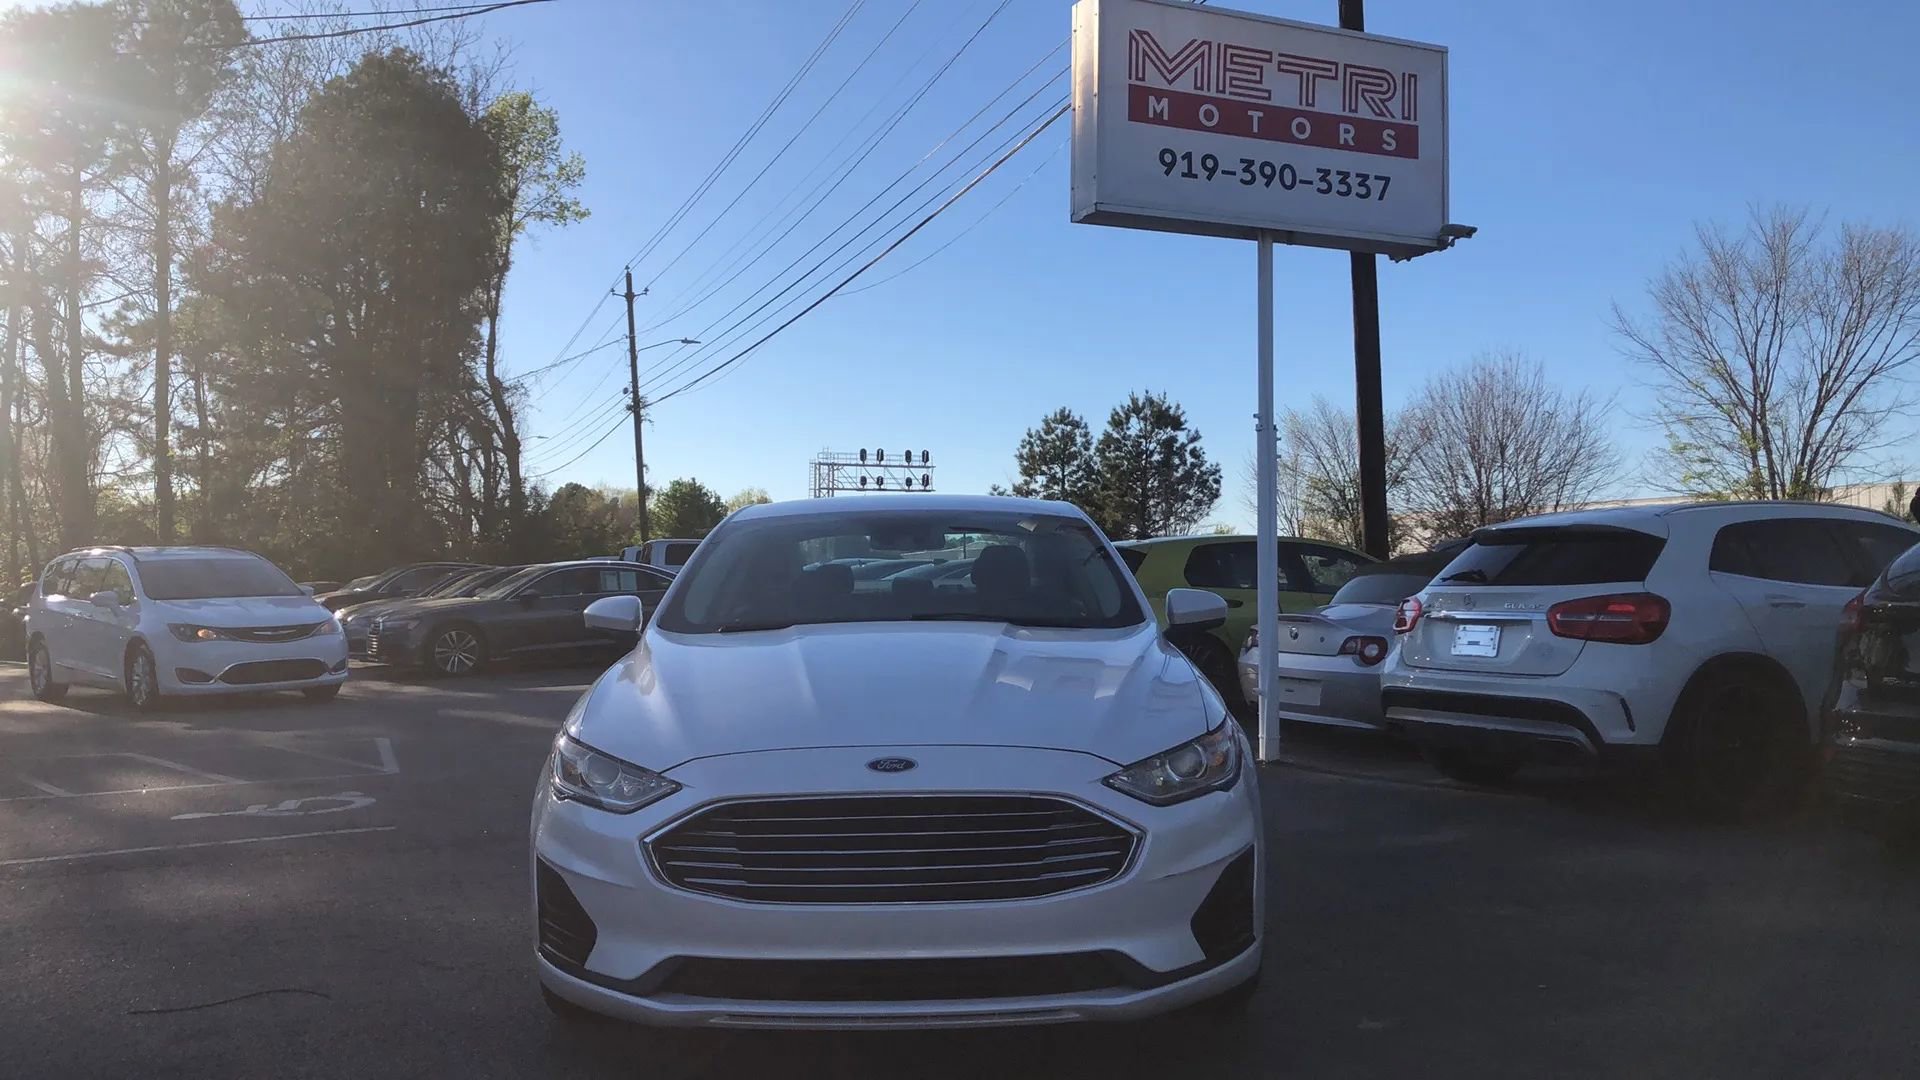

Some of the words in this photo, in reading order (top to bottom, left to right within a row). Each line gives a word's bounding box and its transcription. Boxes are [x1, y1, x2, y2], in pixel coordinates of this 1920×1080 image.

[1128, 29, 1418, 122] METRI
[1148, 96, 1397, 152] MOTORS
[1158, 148, 1392, 201] 919-390-3337
